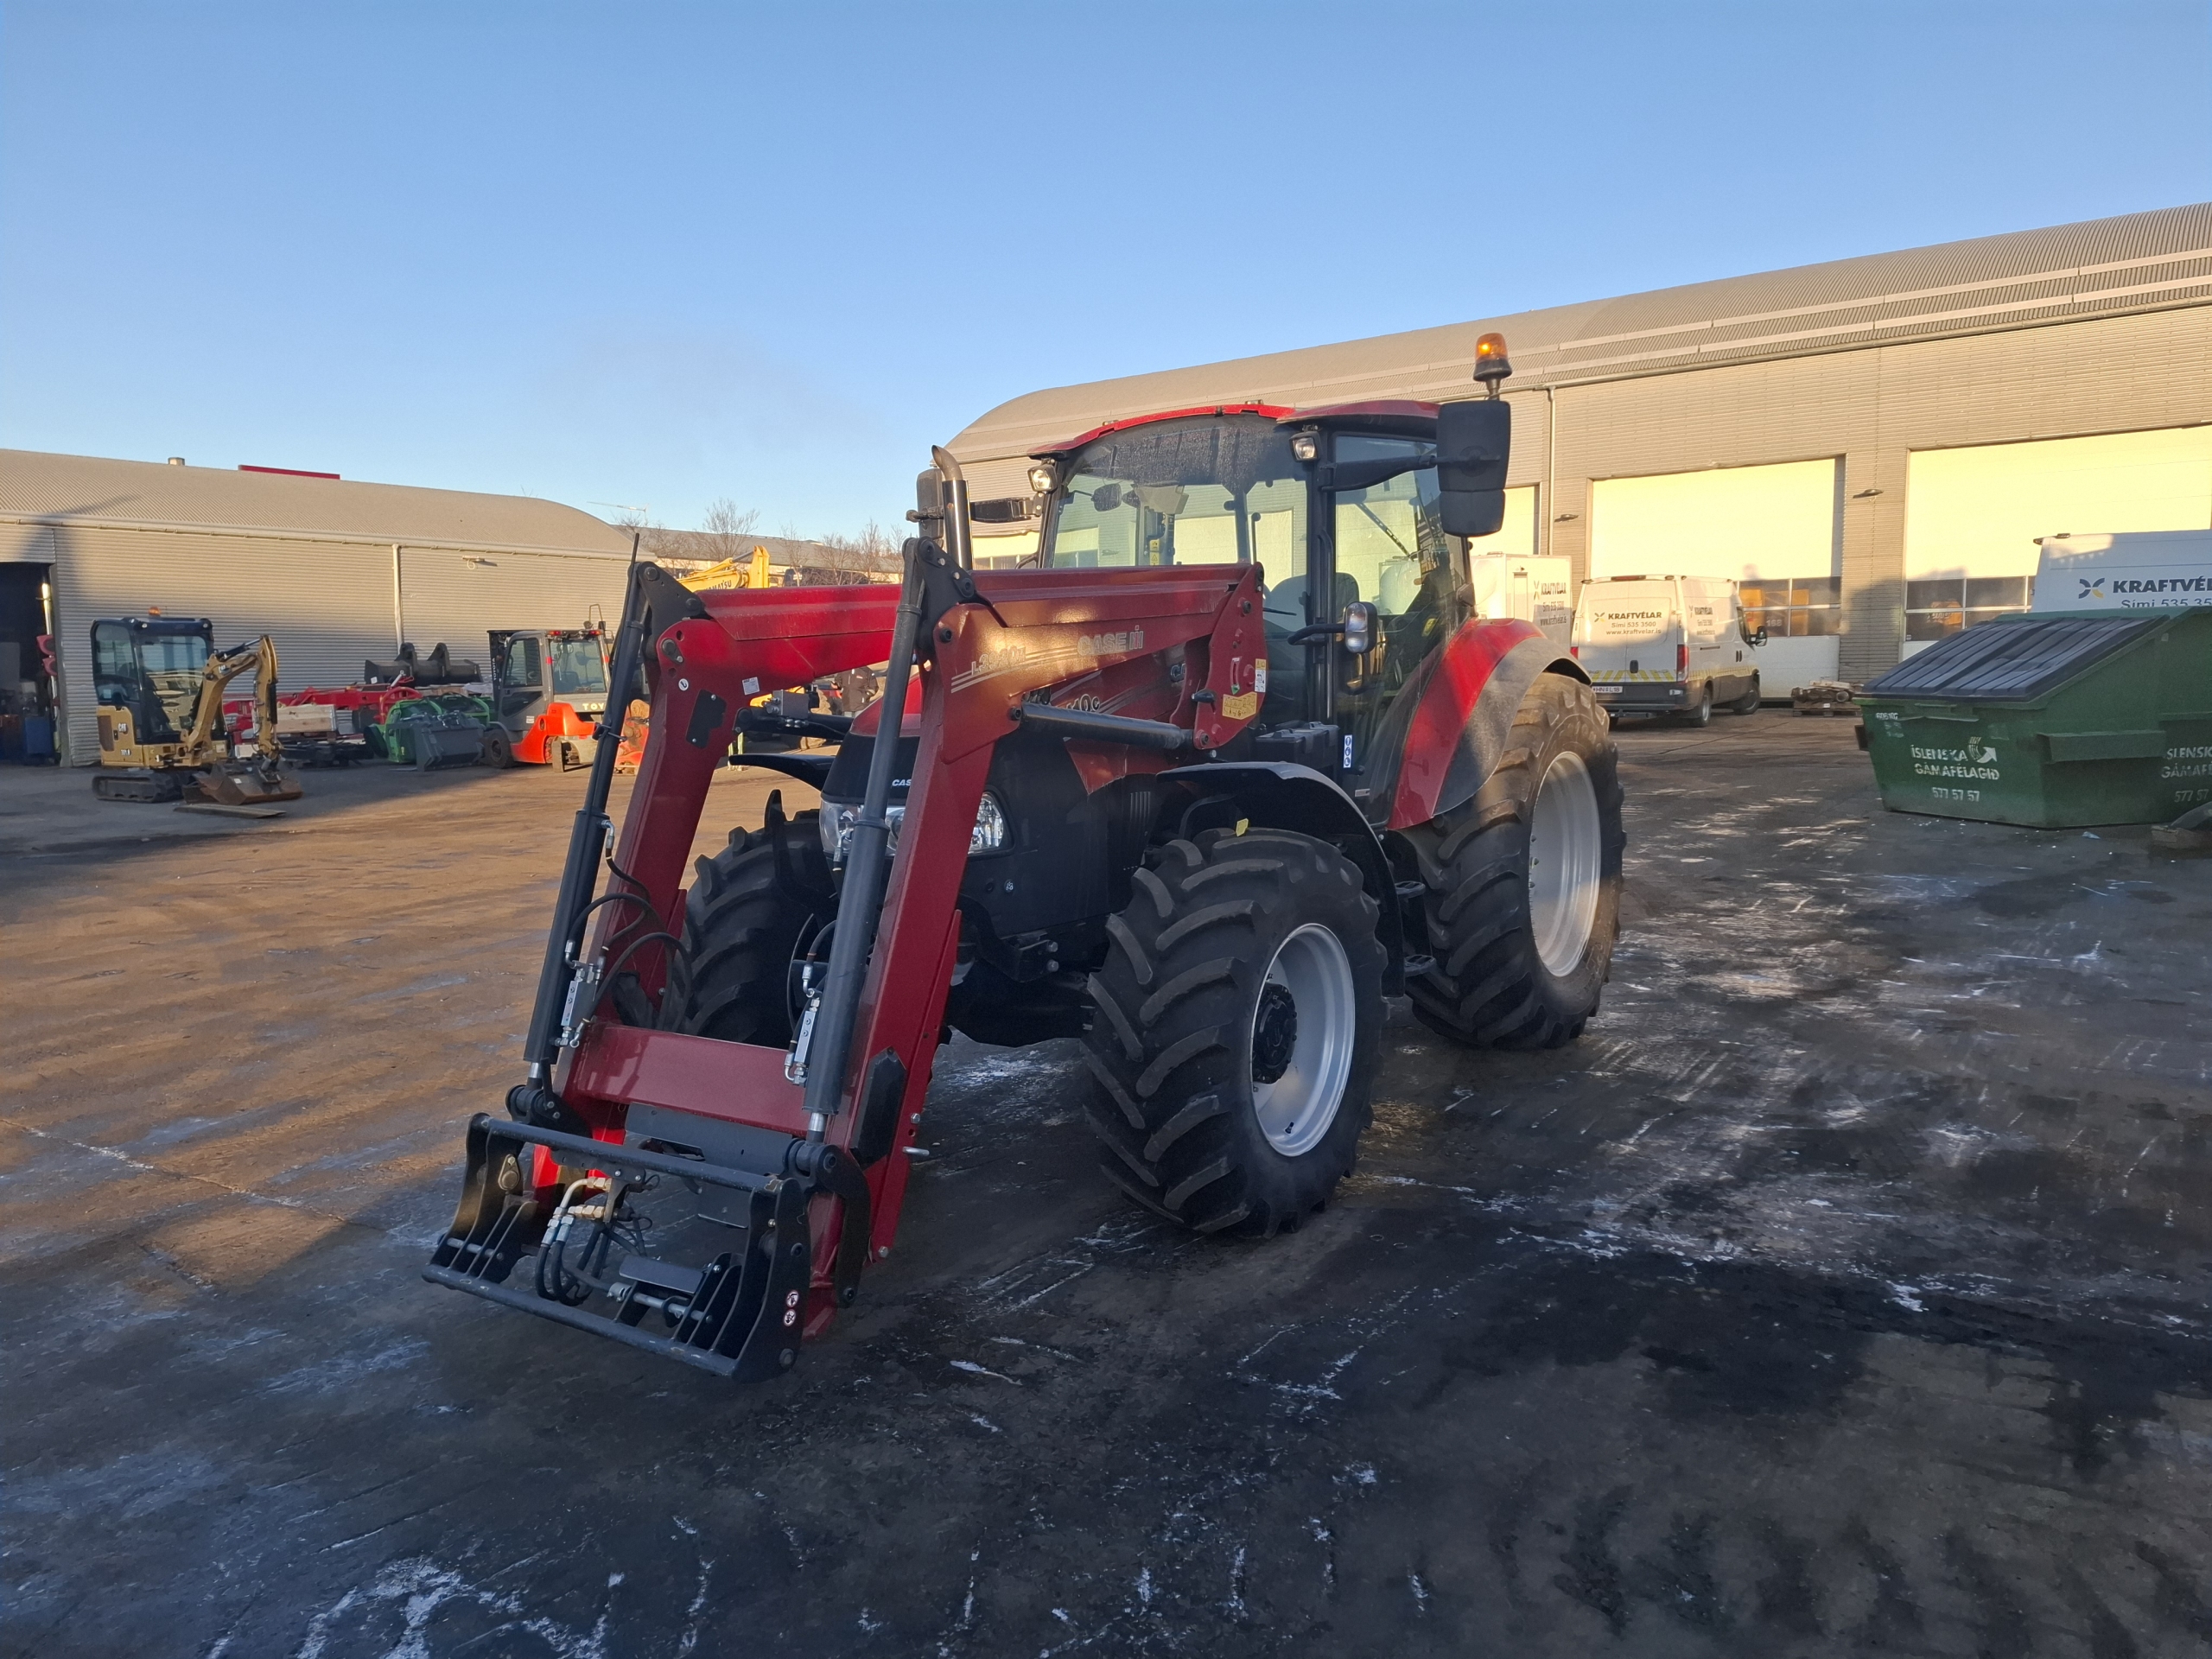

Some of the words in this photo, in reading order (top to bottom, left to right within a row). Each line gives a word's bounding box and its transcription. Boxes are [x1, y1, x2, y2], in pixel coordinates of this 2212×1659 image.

[704, 579, 732, 590] MATSU
[1608, 611, 1662, 620] KRAFTVÉLAR
[1077, 632, 1127, 656] CASE
[1932, 787, 1948, 799] 577
[1952, 789, 1964, 801] 57
[1967, 790, 1980, 802] 57
